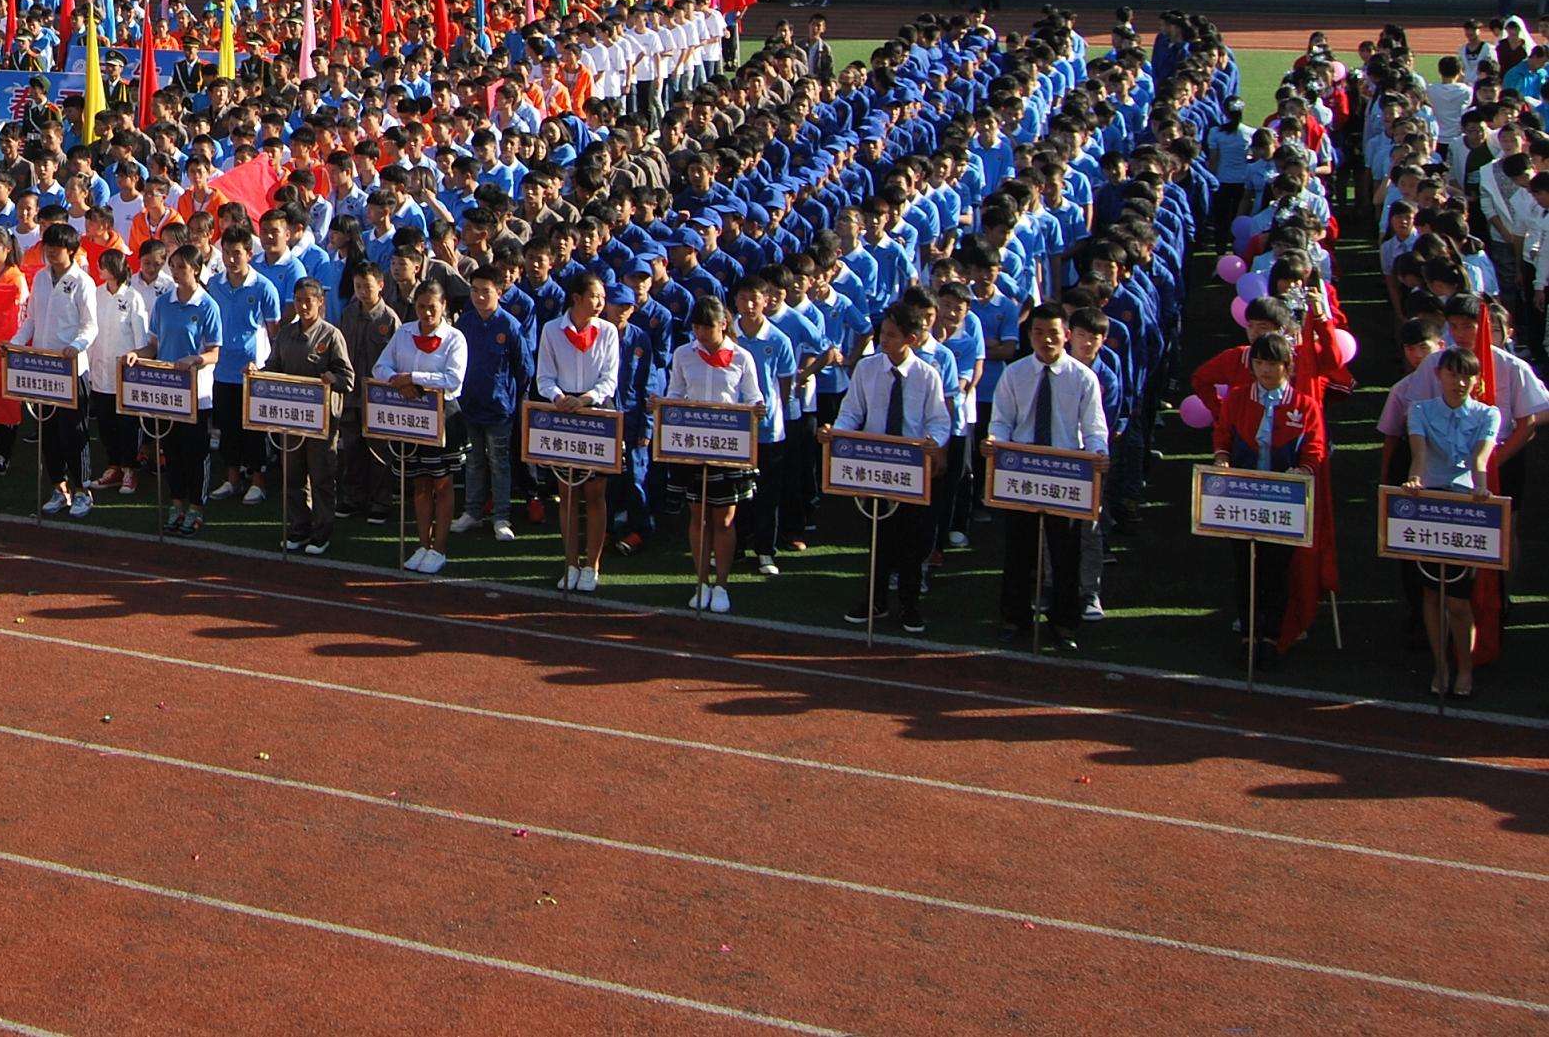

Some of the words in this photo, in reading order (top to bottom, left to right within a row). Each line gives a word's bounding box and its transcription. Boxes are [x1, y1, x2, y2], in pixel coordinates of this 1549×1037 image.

[130, 389, 184, 408] 装饰15级1班
[258, 404, 315, 423] 道桥15级1班
[376, 410, 430, 430] 机电15级2班
[539, 435, 605, 457] 汽修15级1班
[670, 431, 739, 452] 汽修15级2班
[841, 465, 912, 487] 汽修15级4班
[1006, 477, 1082, 502] 汽修15级7班
[1213, 503, 1292, 526] 会计15级1班
[1401, 526, 1489, 552] 会计15级2班
